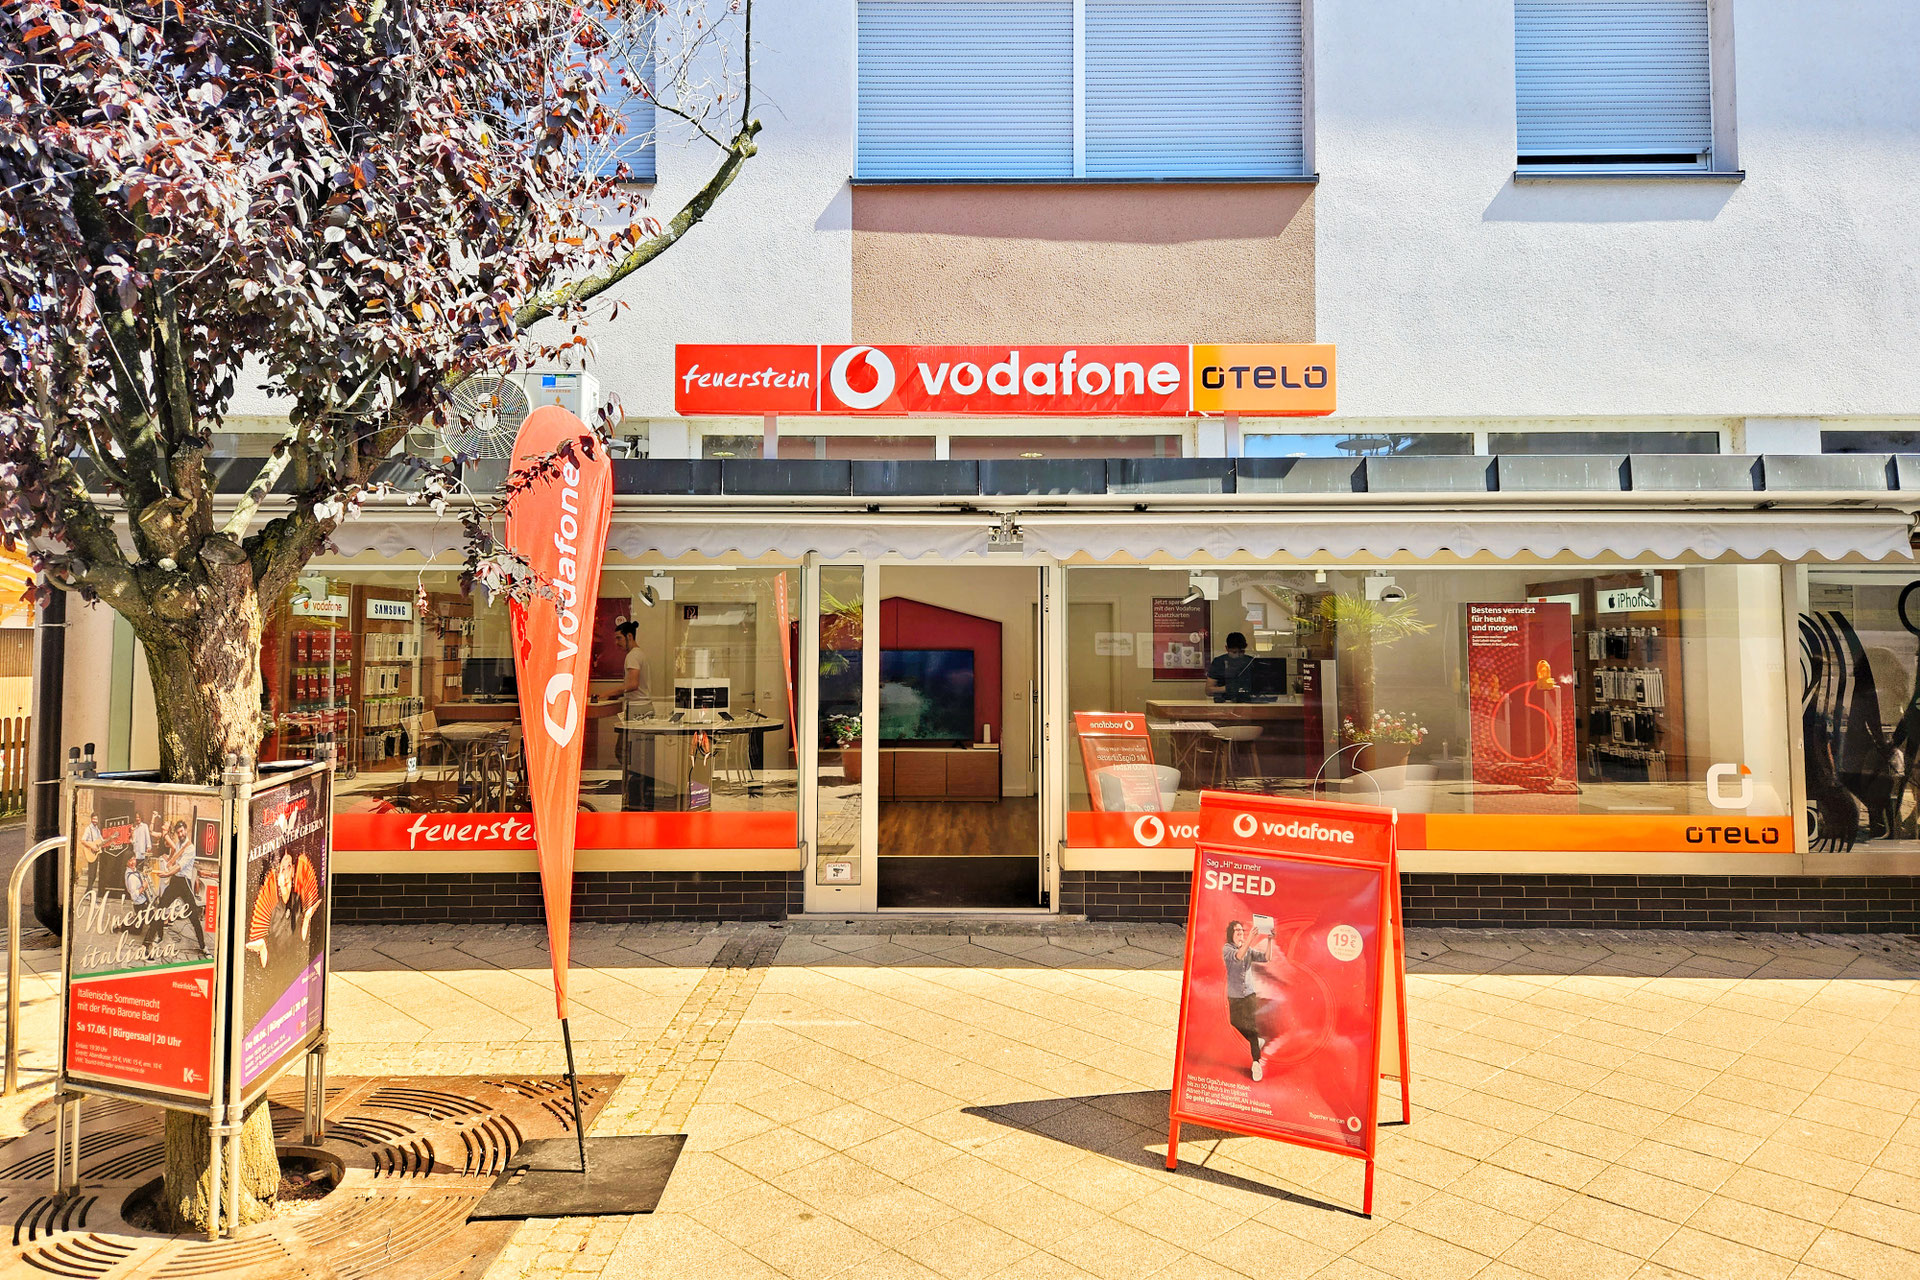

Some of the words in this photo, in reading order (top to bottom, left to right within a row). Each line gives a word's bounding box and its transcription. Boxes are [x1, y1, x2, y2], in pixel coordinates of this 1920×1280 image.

[681, 364, 810, 394] feuerstein
[917, 350, 1181, 396] vodafone
[552, 458, 580, 660] vodafone
[374, 603, 406, 616] SAMSUNG
[1471, 606, 1502, 614] Bestens
[1488, 625, 1519, 633] morgen
[248, 838, 276, 862] ALLEIN
[300, 817, 324, 838] GEIERN
[407, 814, 537, 849] feuerste
[1262, 820, 1355, 844] vodafone
[1206, 858, 1220, 869] Sag
[1243, 863, 1262, 872] mehr
[1204, 871, 1276, 896] SPEED
[80, 930, 181, 969] italiana
[1333, 933, 1349, 947] 19
[77, 988, 113, 1002] Italienische
[114, 993, 160, 1009] Sommernacht
[77, 1001, 88, 1011] mit
[89, 1003, 101, 1013] der
[101, 1004, 116, 1016] Pino
[117, 1007, 141, 1019] Barone
[141, 1010, 160, 1022] Band
[76, 1022, 85, 1031] Sa
[87, 1023, 108, 1035] 17.06.
[113, 1027, 152, 1043] Bürgersaal
[156, 1034, 166, 1045] 20
[167, 1036, 182, 1047] Uhr
[1206, 1077, 1236, 1088] GigaZuhause
[1193, 1095, 1205, 1103] geht
